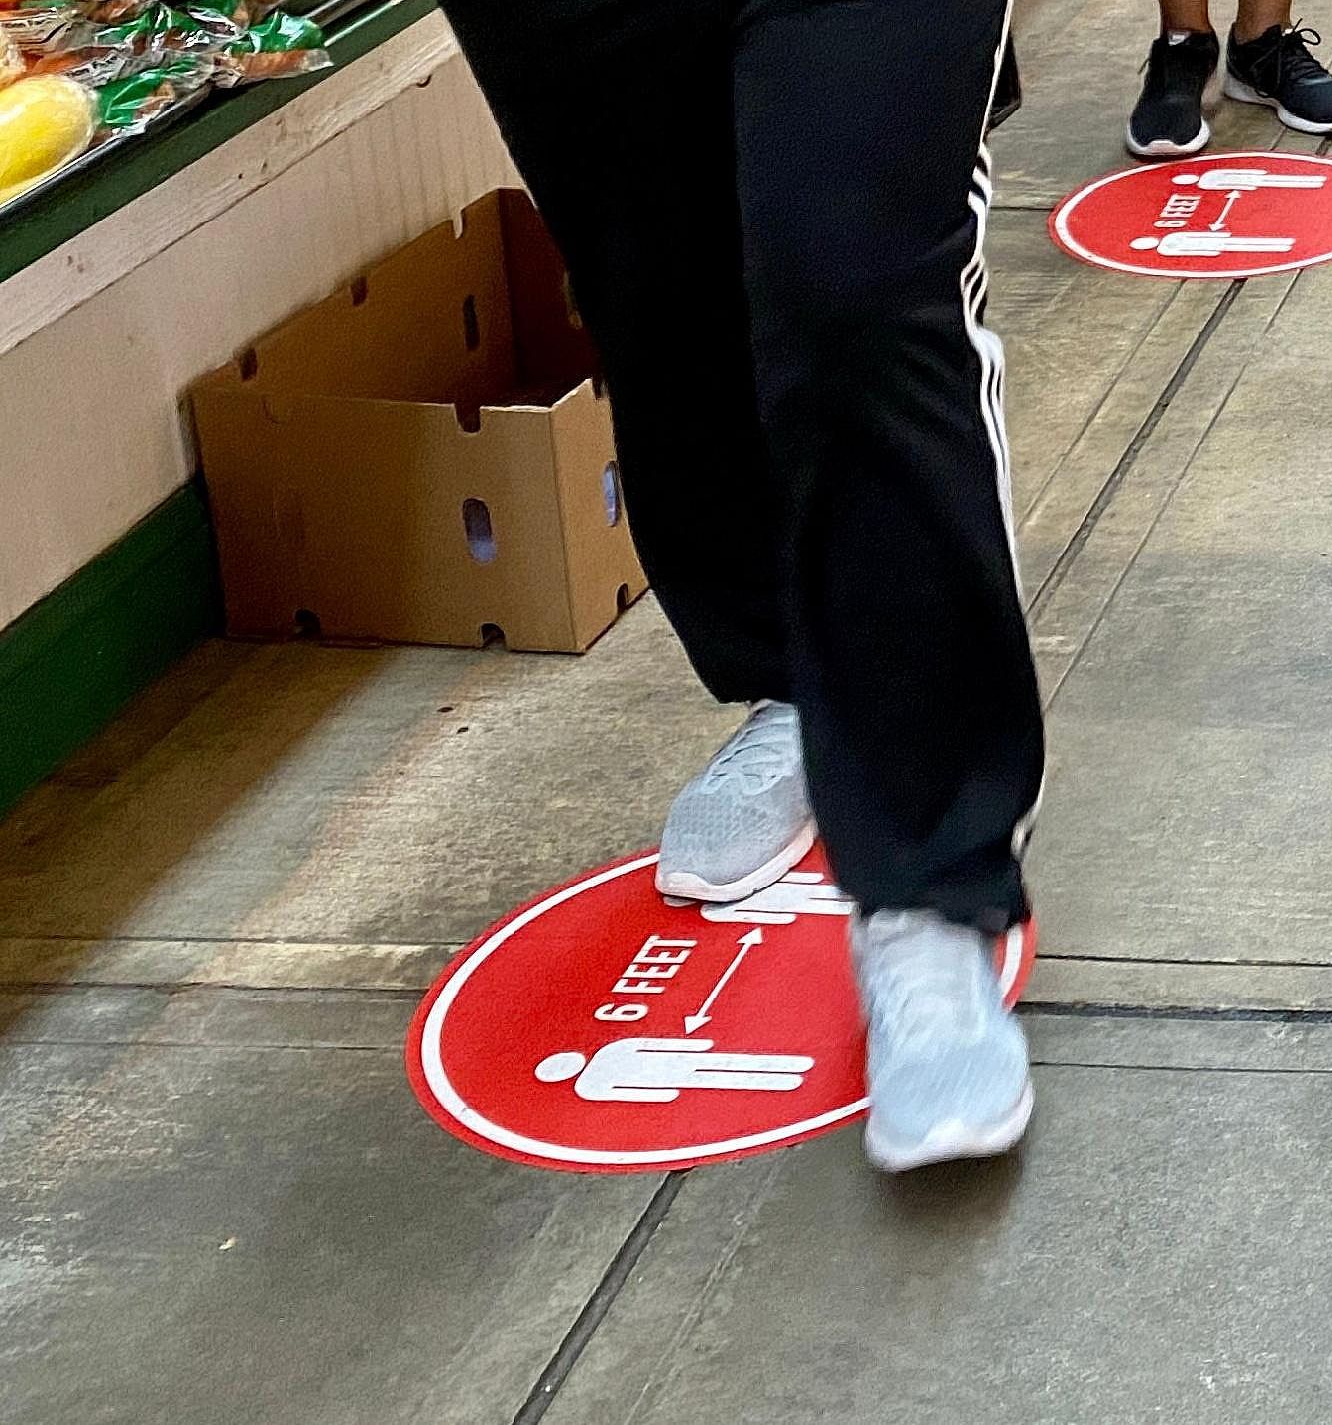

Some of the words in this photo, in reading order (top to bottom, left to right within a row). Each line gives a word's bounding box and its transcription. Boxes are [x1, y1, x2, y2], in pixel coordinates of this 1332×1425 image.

[1160, 193, 1202, 219] FEET
[611, 935, 698, 994] FEET
[594, 1002, 650, 1023] 6
